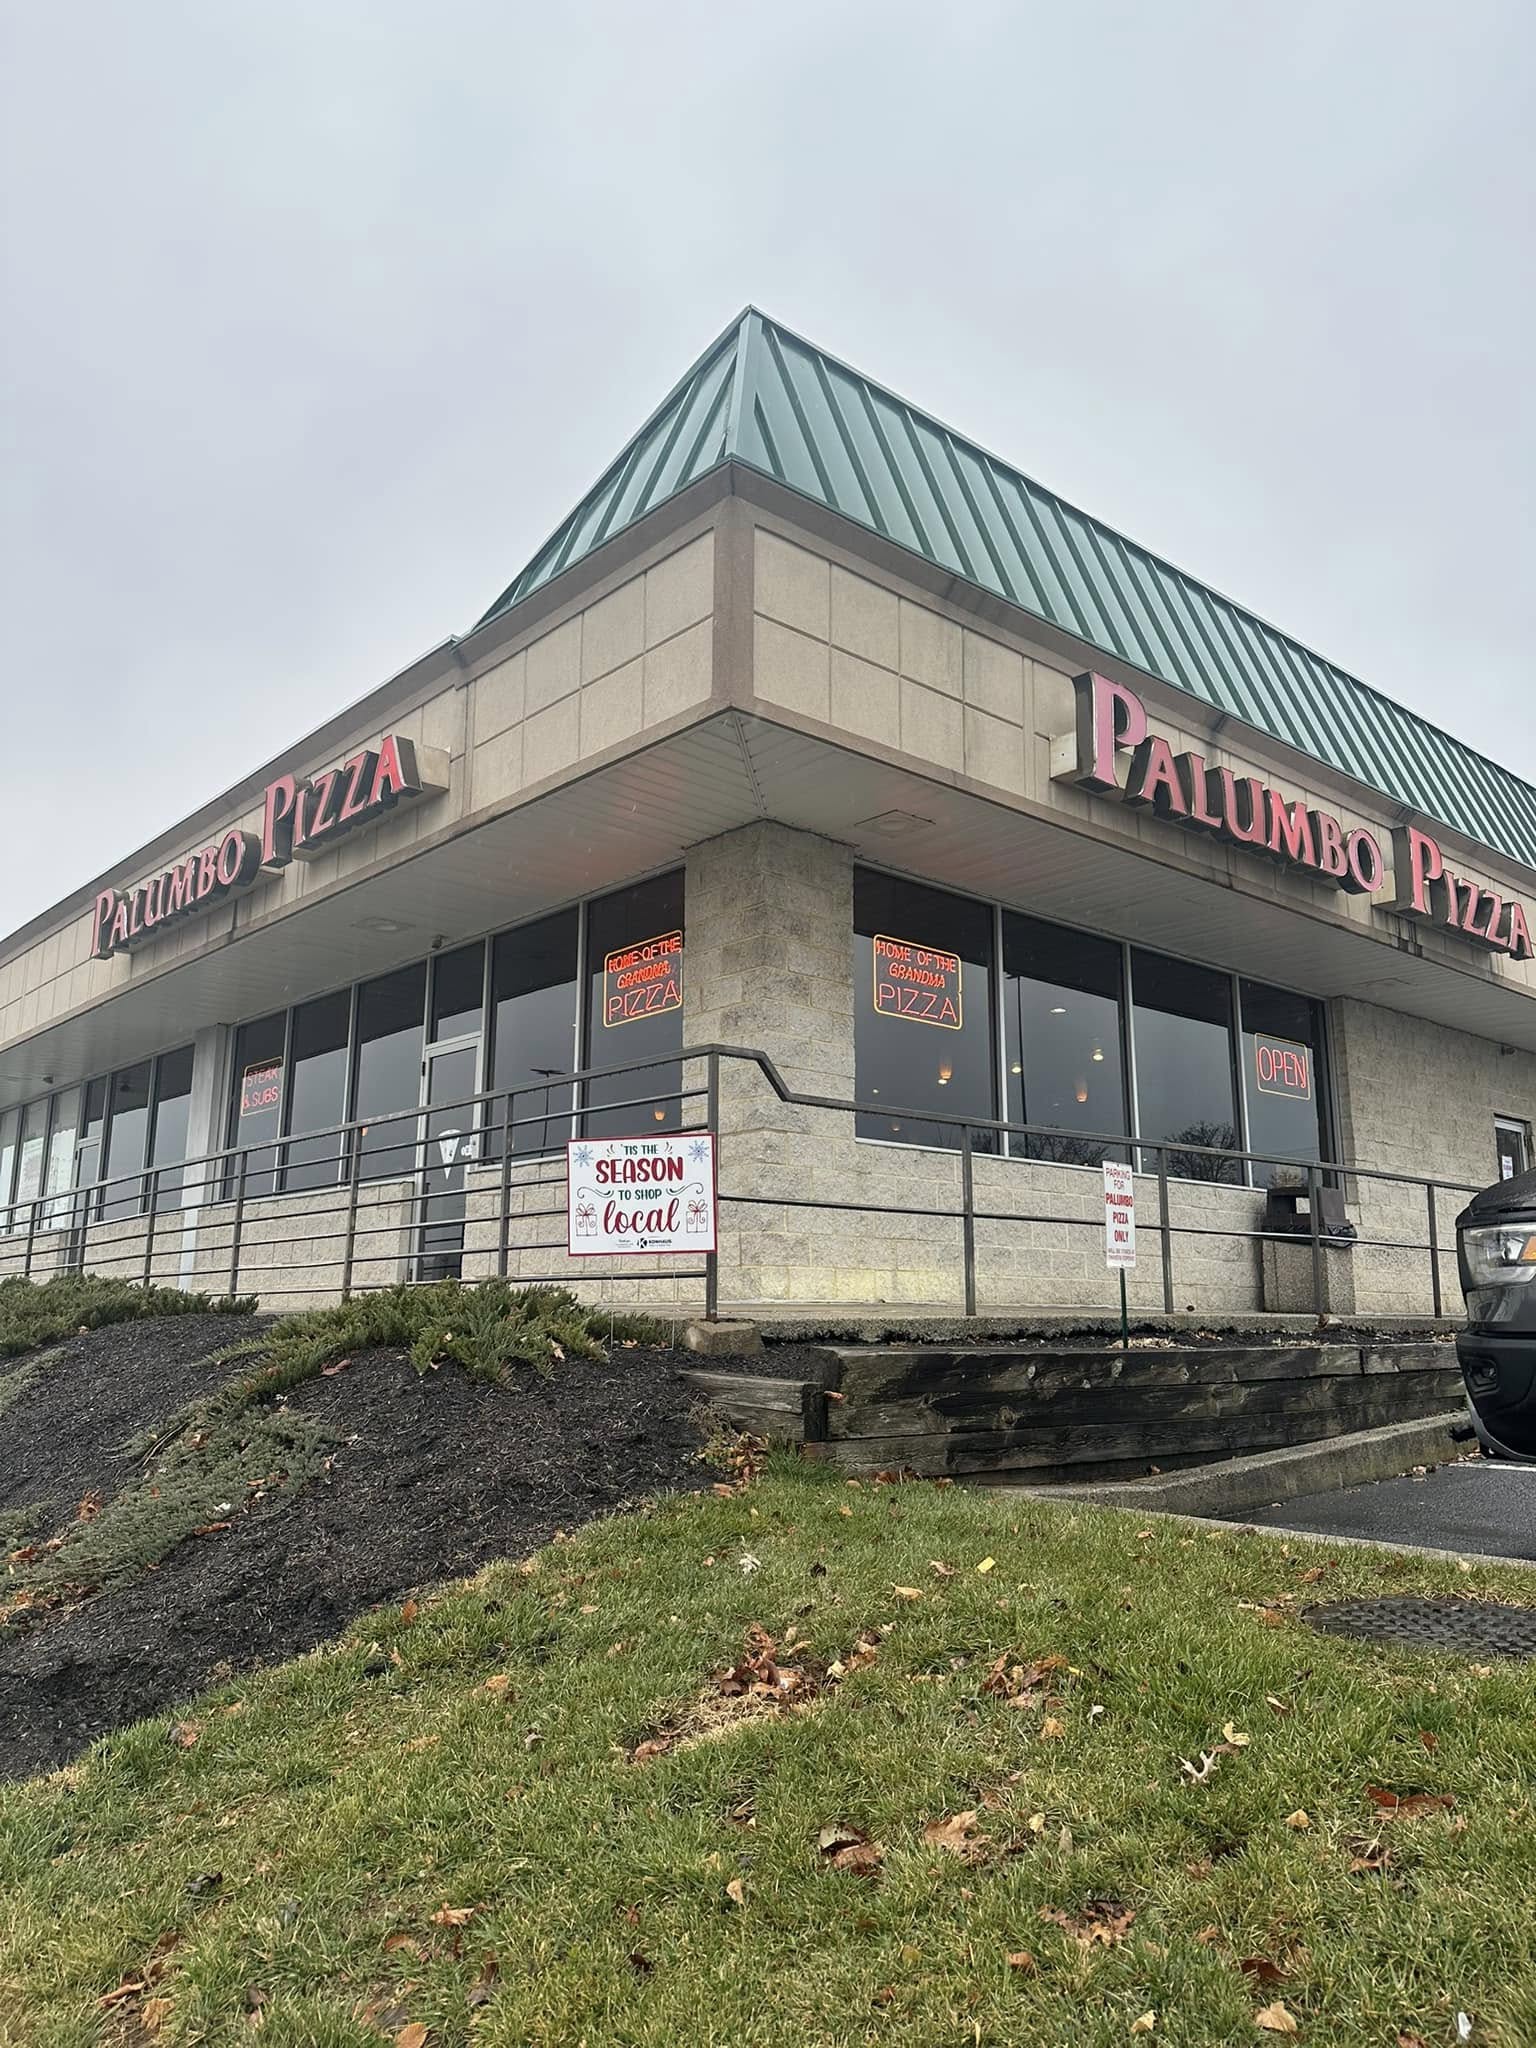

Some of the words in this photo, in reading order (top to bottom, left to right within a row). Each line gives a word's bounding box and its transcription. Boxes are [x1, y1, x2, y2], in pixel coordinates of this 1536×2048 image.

[1084, 671, 1385, 893] PALUMBO
[1404, 826, 1535, 958] PIZZA
[90, 829, 248, 959] PALUMBO
[261, 734, 409, 866] PIZZA
[608, 951, 639, 973] HOME
[642, 944, 658, 961] OF
[658, 936, 682, 956] THE
[876, 940, 912, 961] HOME
[917, 951, 932, 966] OF
[933, 954, 957, 973] THE
[617, 960, 671, 989] GRANDMA
[889, 962, 946, 988] GRANDMA
[608, 980, 680, 1021] PIZZA
[878, 983, 957, 1022] PIZZA
[246, 1065, 278, 1088] STEAK
[1258, 1046, 1307, 1089] OPEN
[252, 1086, 279, 1107] SUBS
[641, 1143, 659, 1155] THE
[595, 1156, 684, 1184] SEASON
[1105, 1167, 1131, 1180] PARKING
[618, 1189, 632, 1201] TO
[634, 1188, 662, 1200] SHOP
[1113, 1179, 1125, 1190] FOR
[1105, 1192, 1133, 1208] PALUMBO
[603, 1197, 681, 1235] local
[1112, 1211, 1129, 1225] PIZZA
[1113, 1230, 1129, 1243] ONLY
